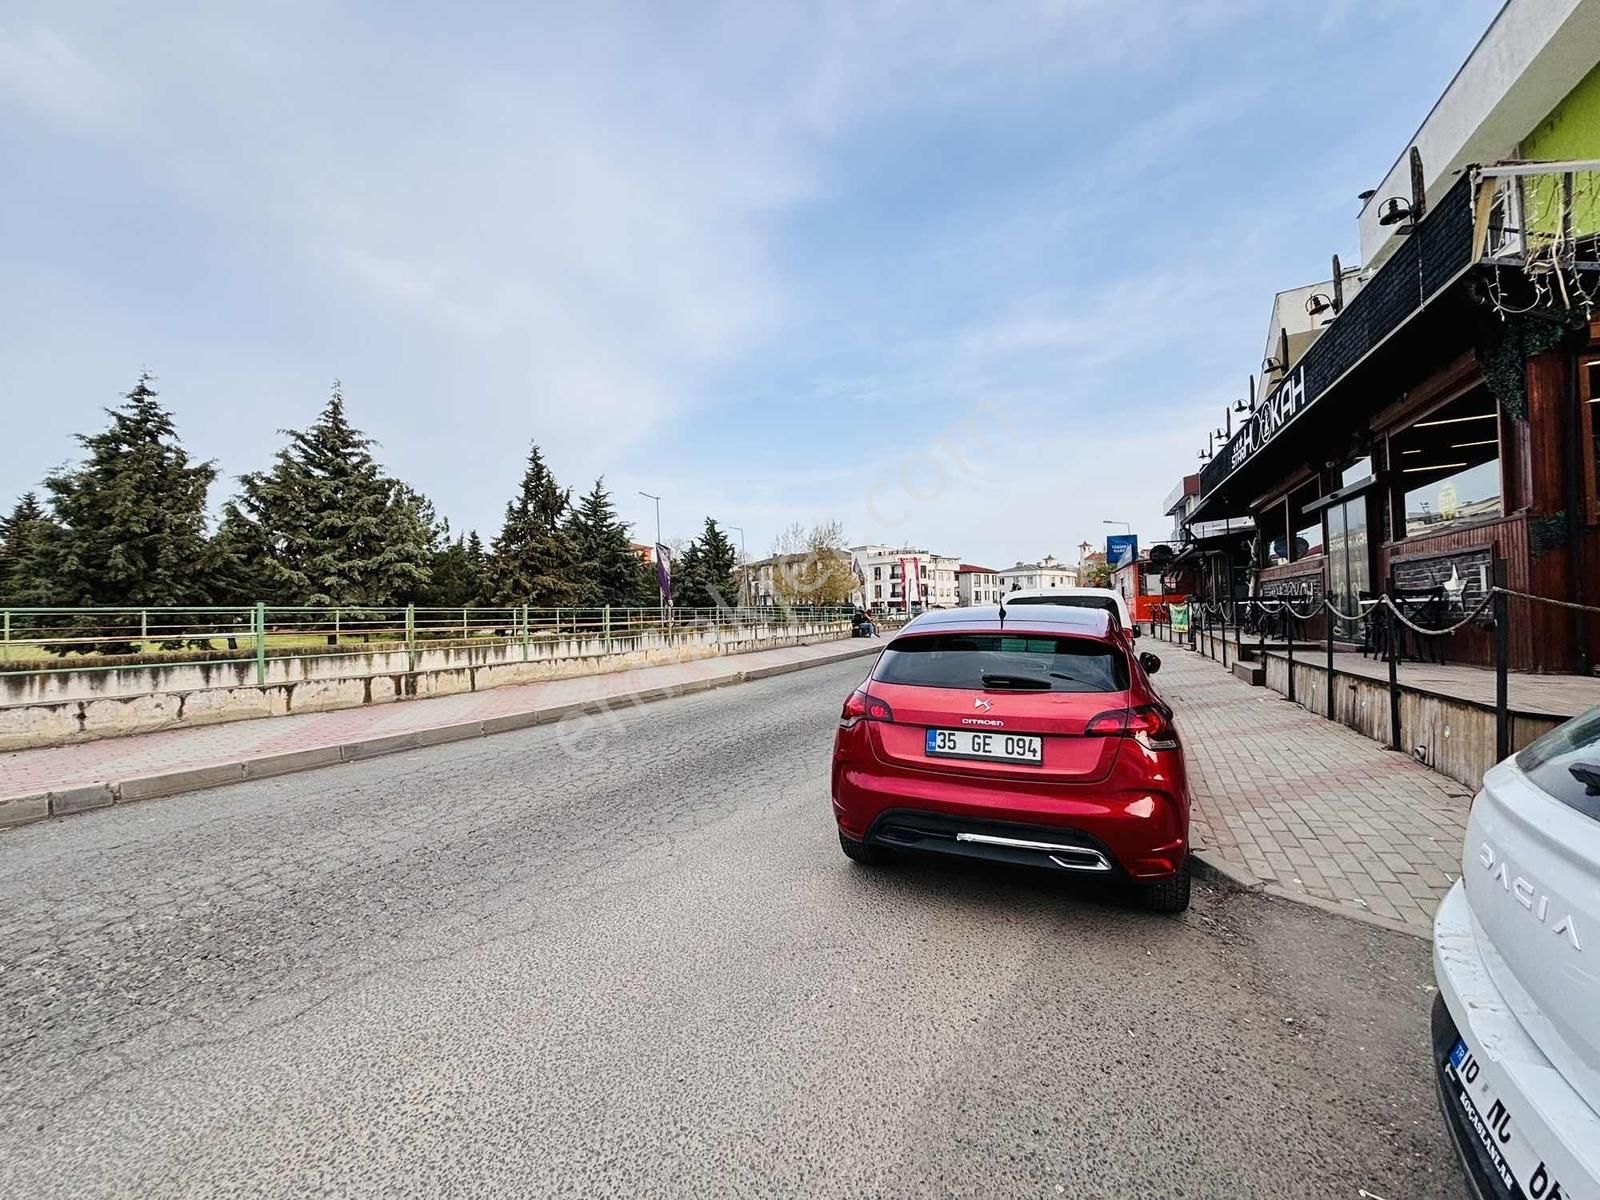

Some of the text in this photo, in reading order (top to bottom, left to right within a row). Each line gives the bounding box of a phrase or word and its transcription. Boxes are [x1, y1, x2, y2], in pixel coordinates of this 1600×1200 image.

[1244, 365, 1305, 453] HOOKAH
[937, 732, 1038, 758] 35 GE 094
[1479, 842, 1582, 952] DACIA
[1459, 1090, 1514, 1190] KOÇASLANLAR
